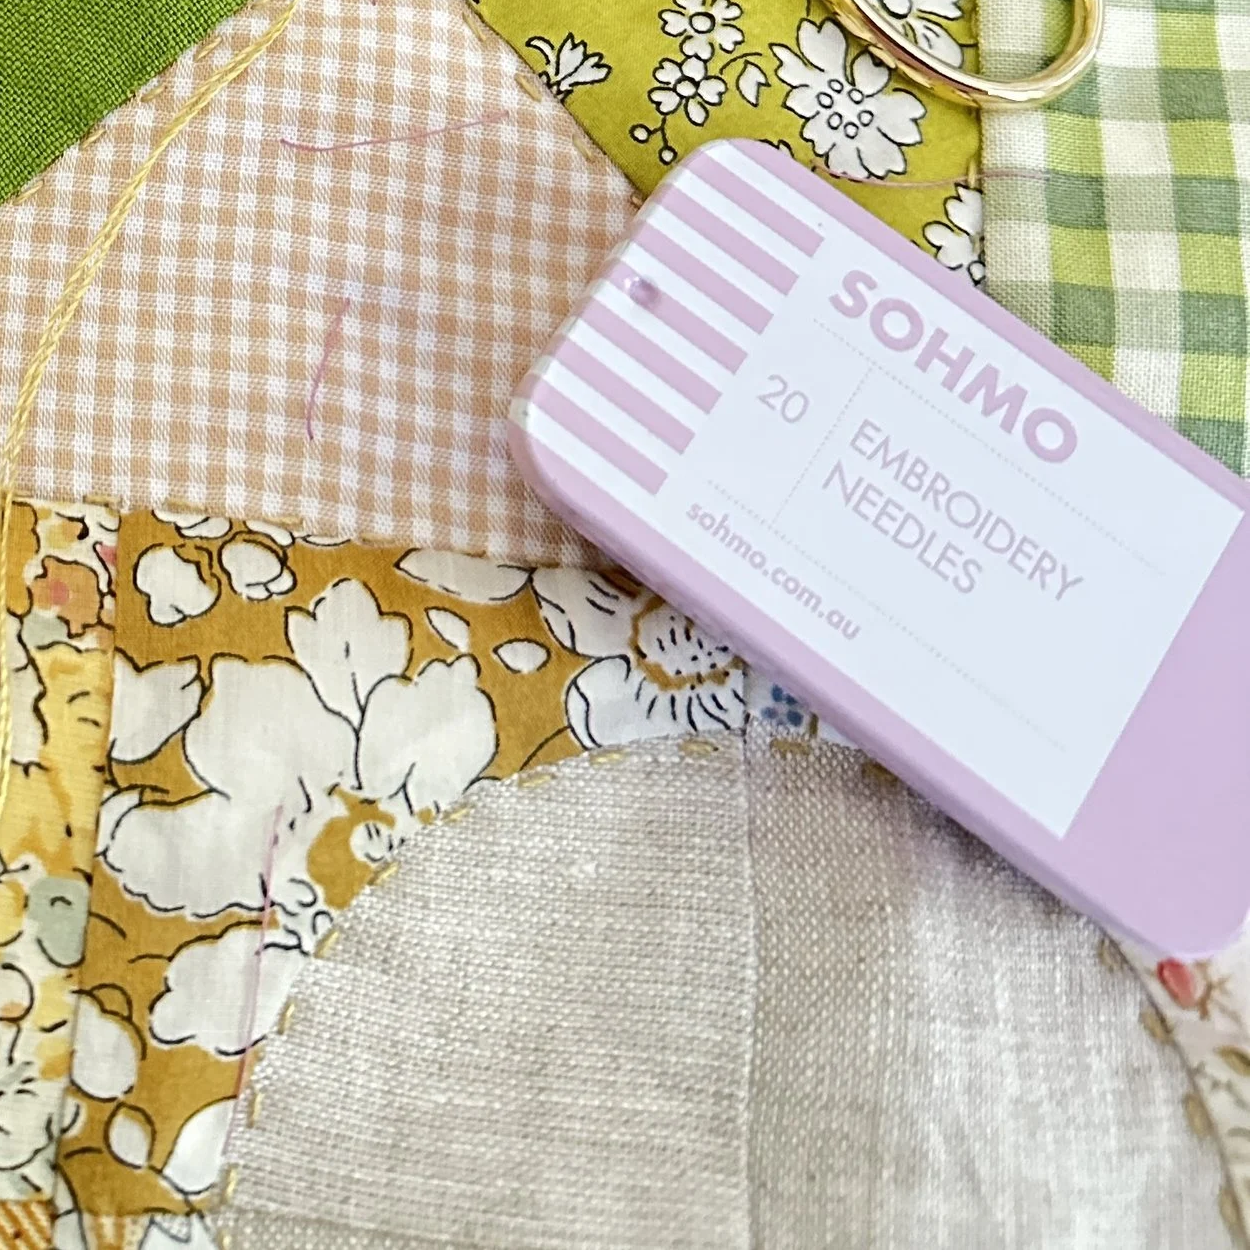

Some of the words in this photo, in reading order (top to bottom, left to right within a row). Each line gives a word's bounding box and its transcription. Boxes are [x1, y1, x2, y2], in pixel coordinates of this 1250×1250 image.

[755, 373, 810, 425] 20
[828, 268, 1079, 464] SOHMO
[685, 499, 862, 642] sohmo.com.au
[822, 459, 983, 595] NEEDLES
[849, 418, 1085, 602] EMBROIDERY
